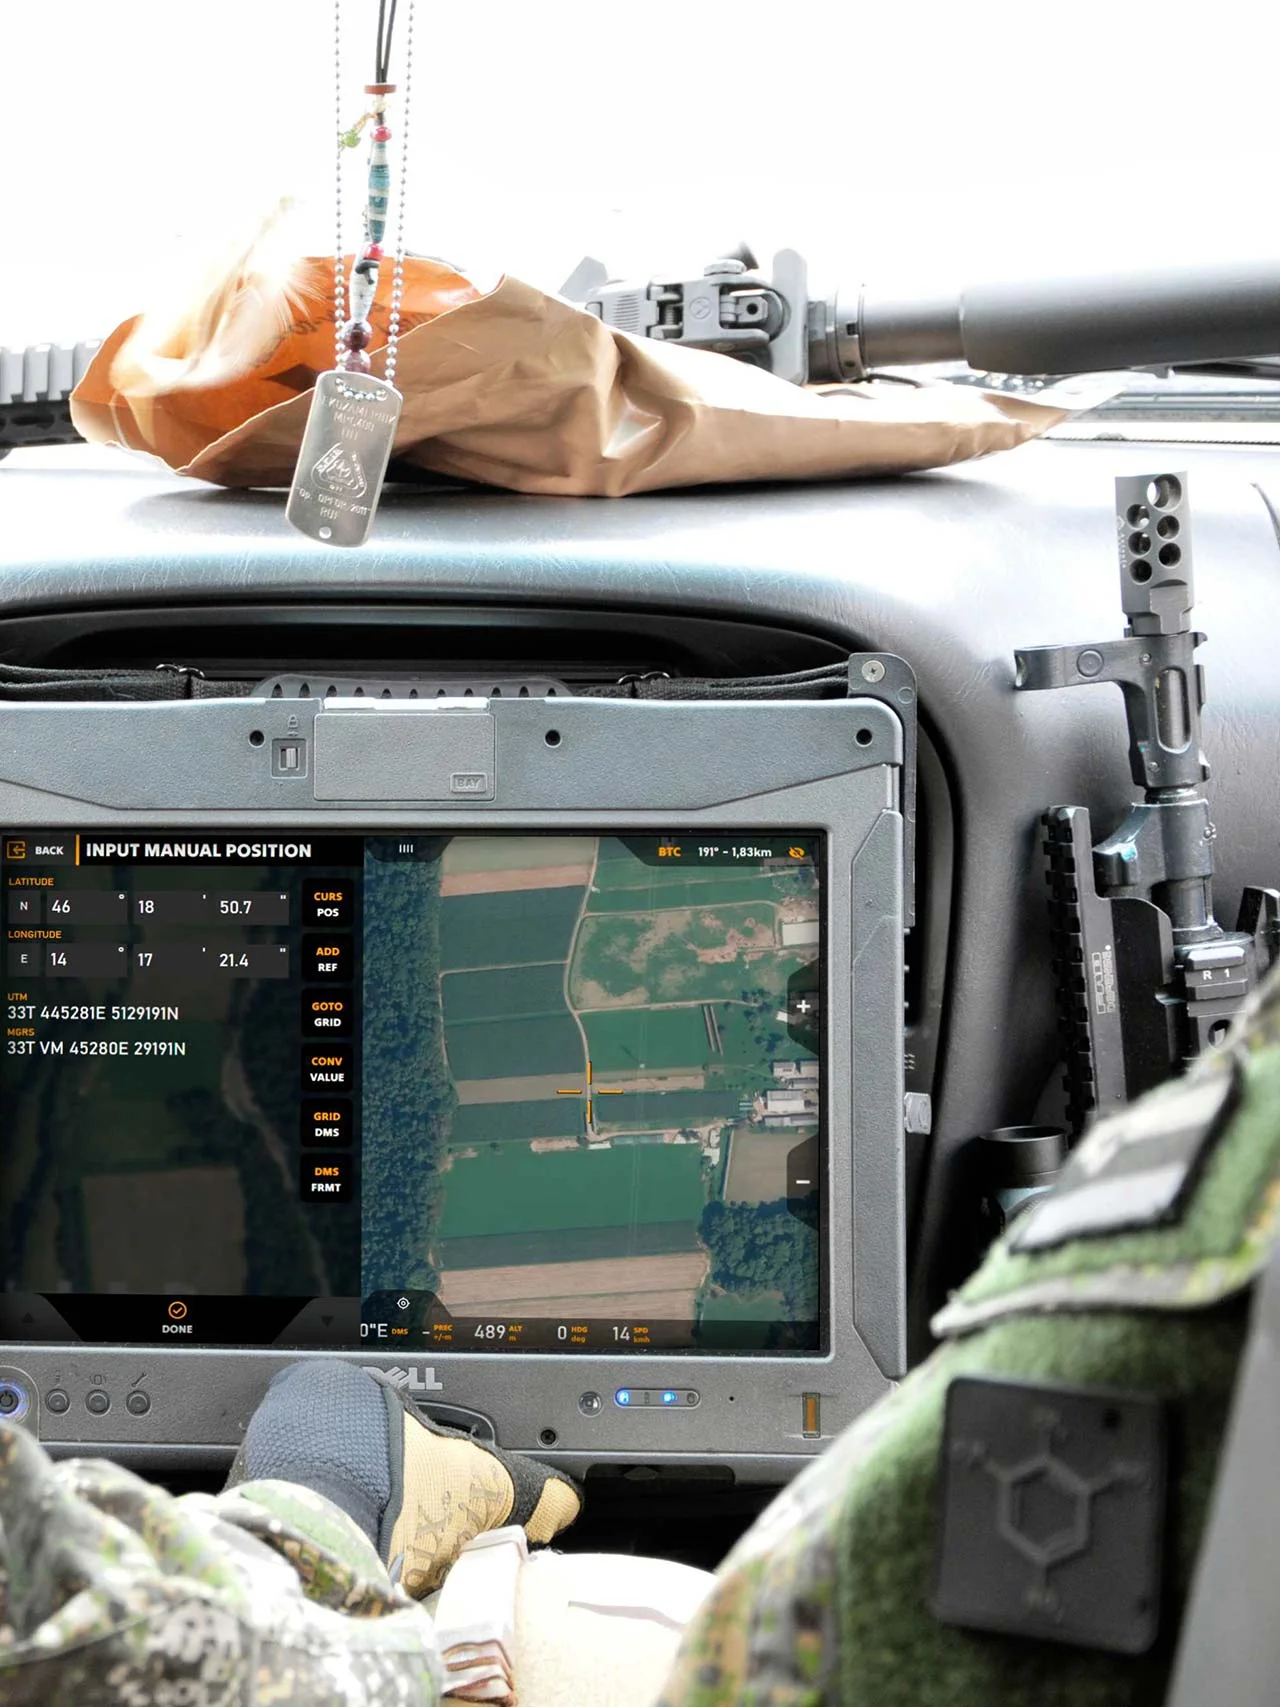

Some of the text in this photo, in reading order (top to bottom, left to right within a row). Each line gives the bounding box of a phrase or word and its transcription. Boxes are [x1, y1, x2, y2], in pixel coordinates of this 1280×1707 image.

[455, 777, 482, 789] BAY
[35, 846, 64, 855] BACK
[86, 843, 312, 858] INPUT MANUAL POSITION
[658, 846, 681, 857] BTC
[698, 846, 719, 857] 191°
[731, 846, 772, 859] 1,83km
[8, 877, 55, 887] LATITUDE
[313, 892, 343, 901] CURS
[20, 899, 252, 914] N 46 18 50.7
[317, 907, 339, 917] POS
[8, 930, 62, 939] LONGITUDE
[316, 947, 340, 956] ADD
[20, 952, 249, 967] E 14 17 21.4
[318, 962, 338, 972] REF
[1202, 967, 1231, 981] R 1
[7, 992, 28, 1001] UTM
[311, 1001, 344, 1012] GOTO
[7, 1005, 179, 1021] 33T 445281E 5129191N
[314, 1017, 342, 1027] GRID
[7, 1027, 35, 1037] MGRS
[7, 1040, 186, 1056] 33T VM 45280E 29191N
[311, 1056, 343, 1066] CONV
[309, 1072, 345, 1082] VALUE
[313, 1111, 341, 1121] GRID
[314, 1127, 340, 1137] DMS
[314, 1167, 340, 1176] DMS
[311, 1182, 342, 1192] FRMT
[162, 1324, 193, 1334] DONE
[474, 1324, 506, 1339] 489
[557, 1325, 567, 1340] 0
[612, 1326, 630, 1341] 14
